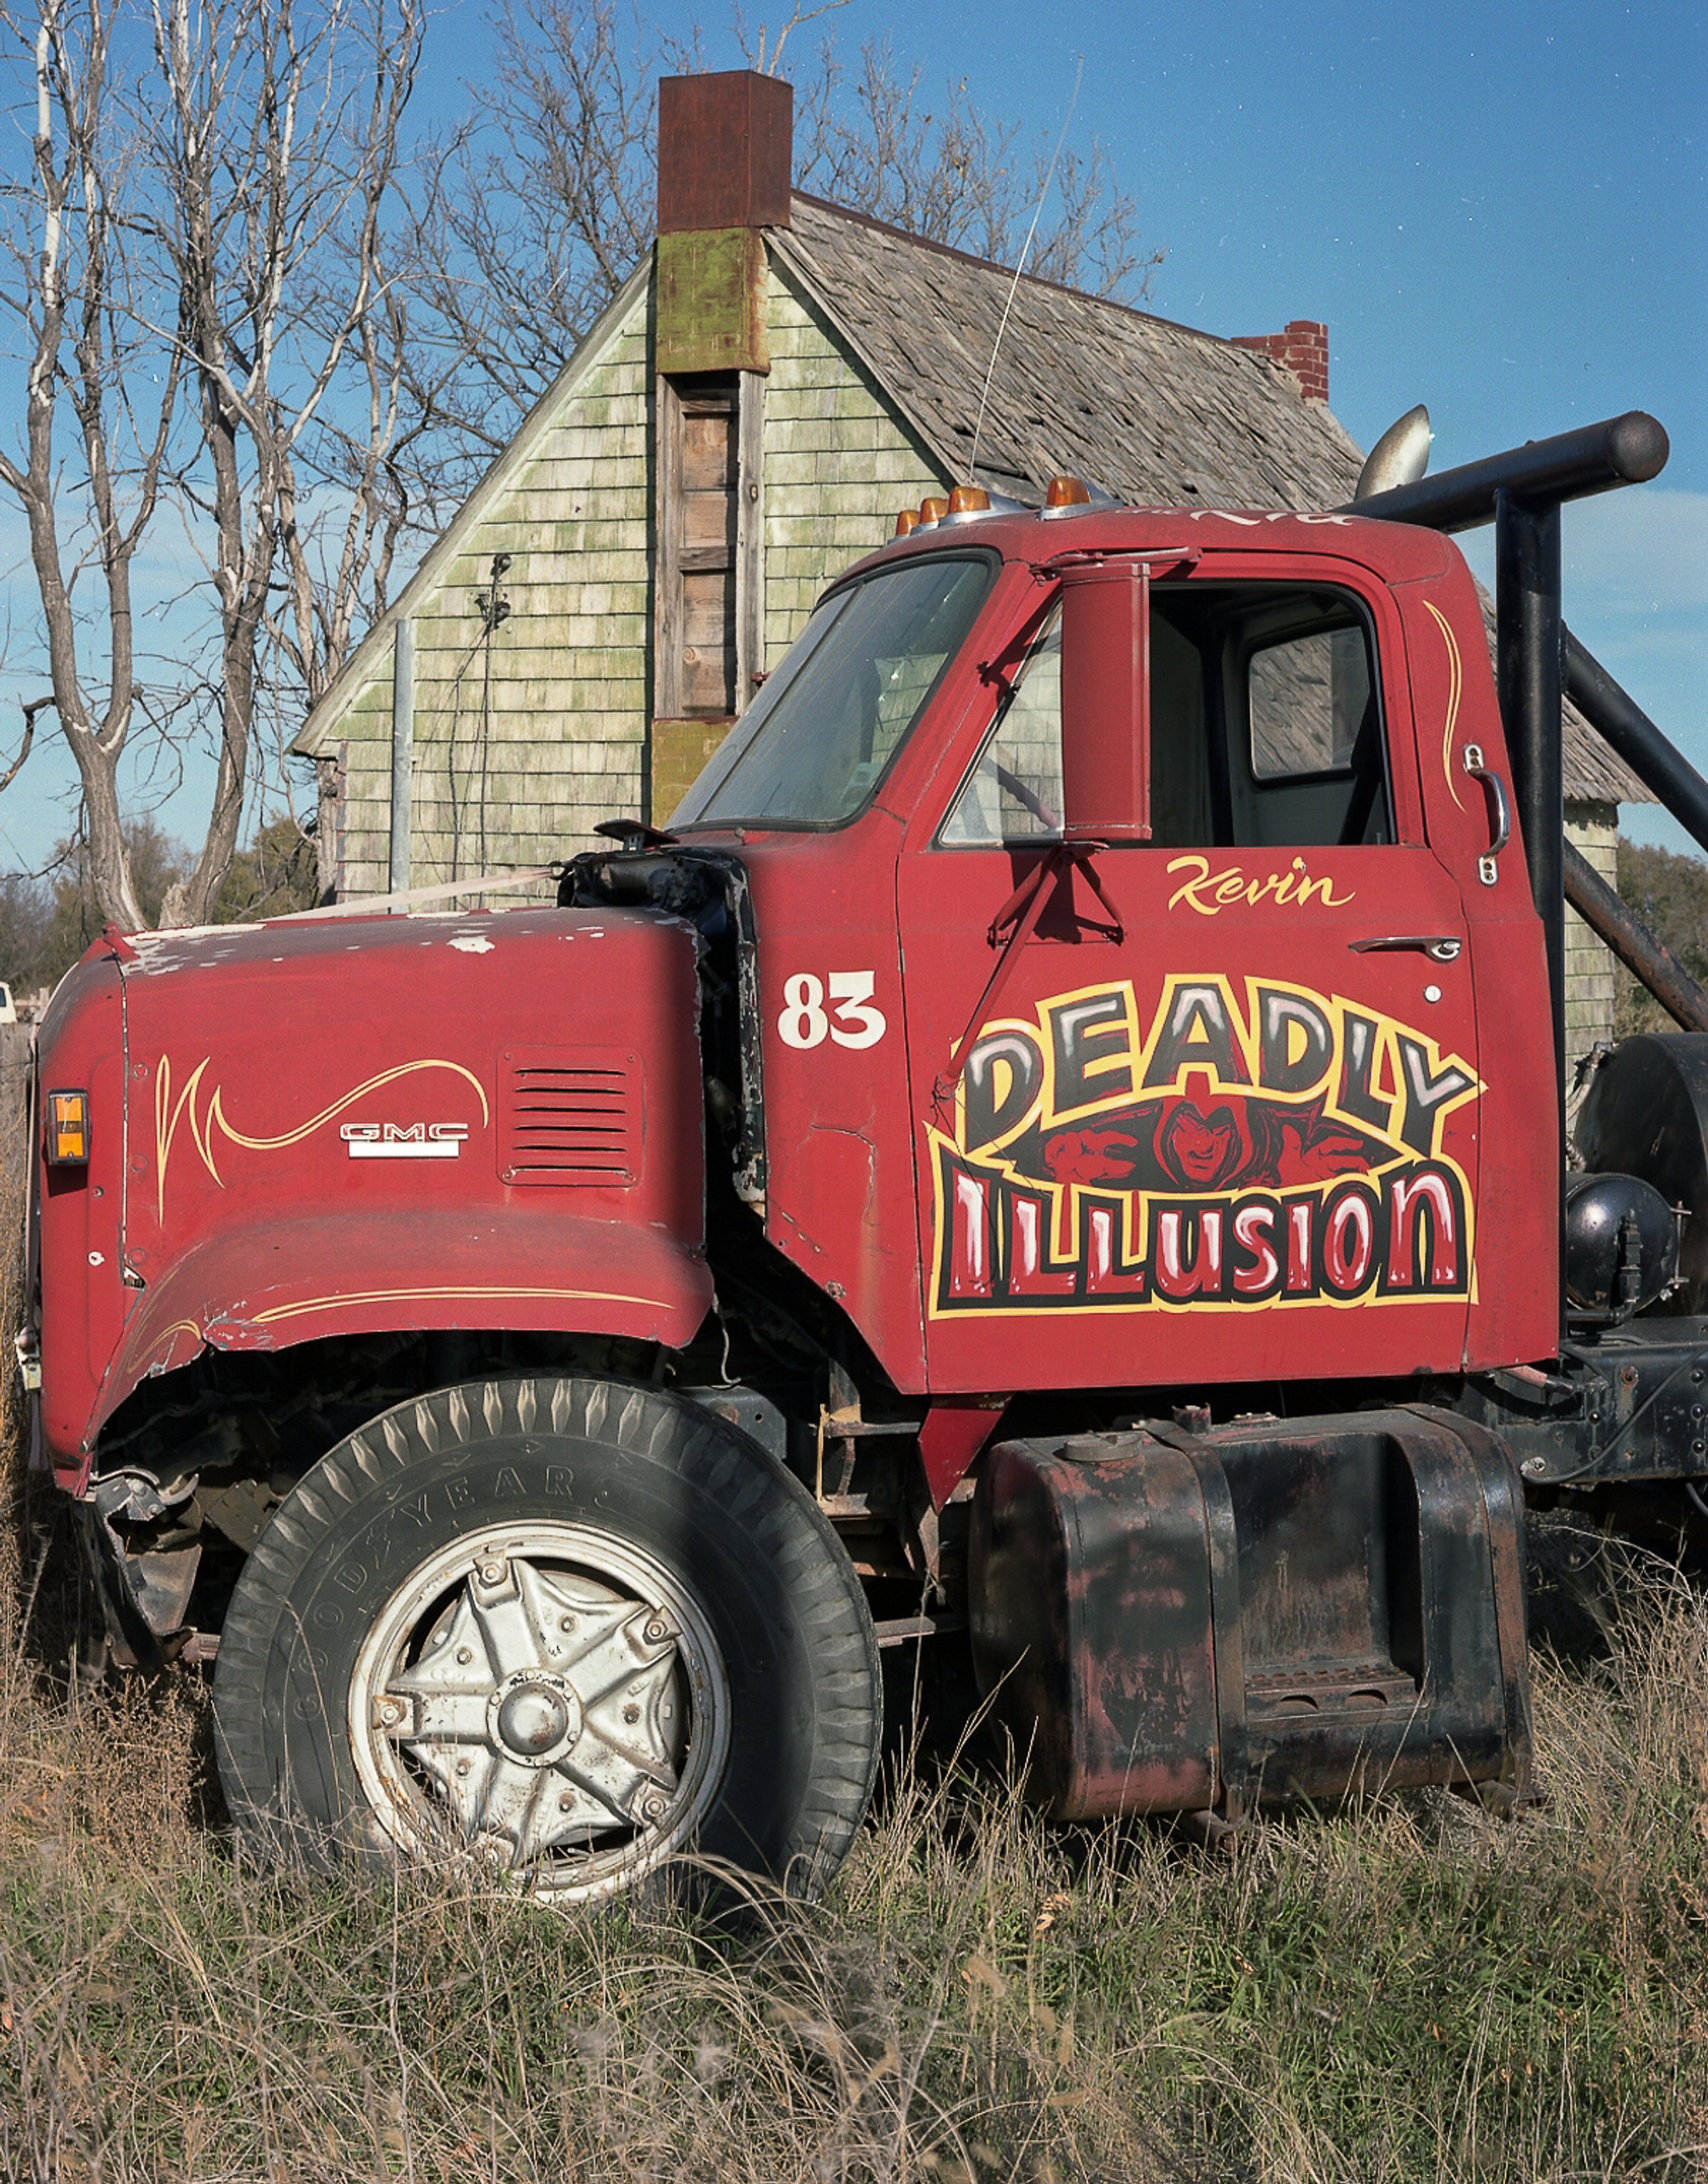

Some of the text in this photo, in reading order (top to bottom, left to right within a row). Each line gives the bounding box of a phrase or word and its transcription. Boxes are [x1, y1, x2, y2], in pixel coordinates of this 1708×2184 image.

[1166, 855, 1356, 915] Kevin
[778, 970, 887, 1050] 83
[954, 975, 1485, 1157] DEADLY
[340, 1123, 469, 1140] GMC
